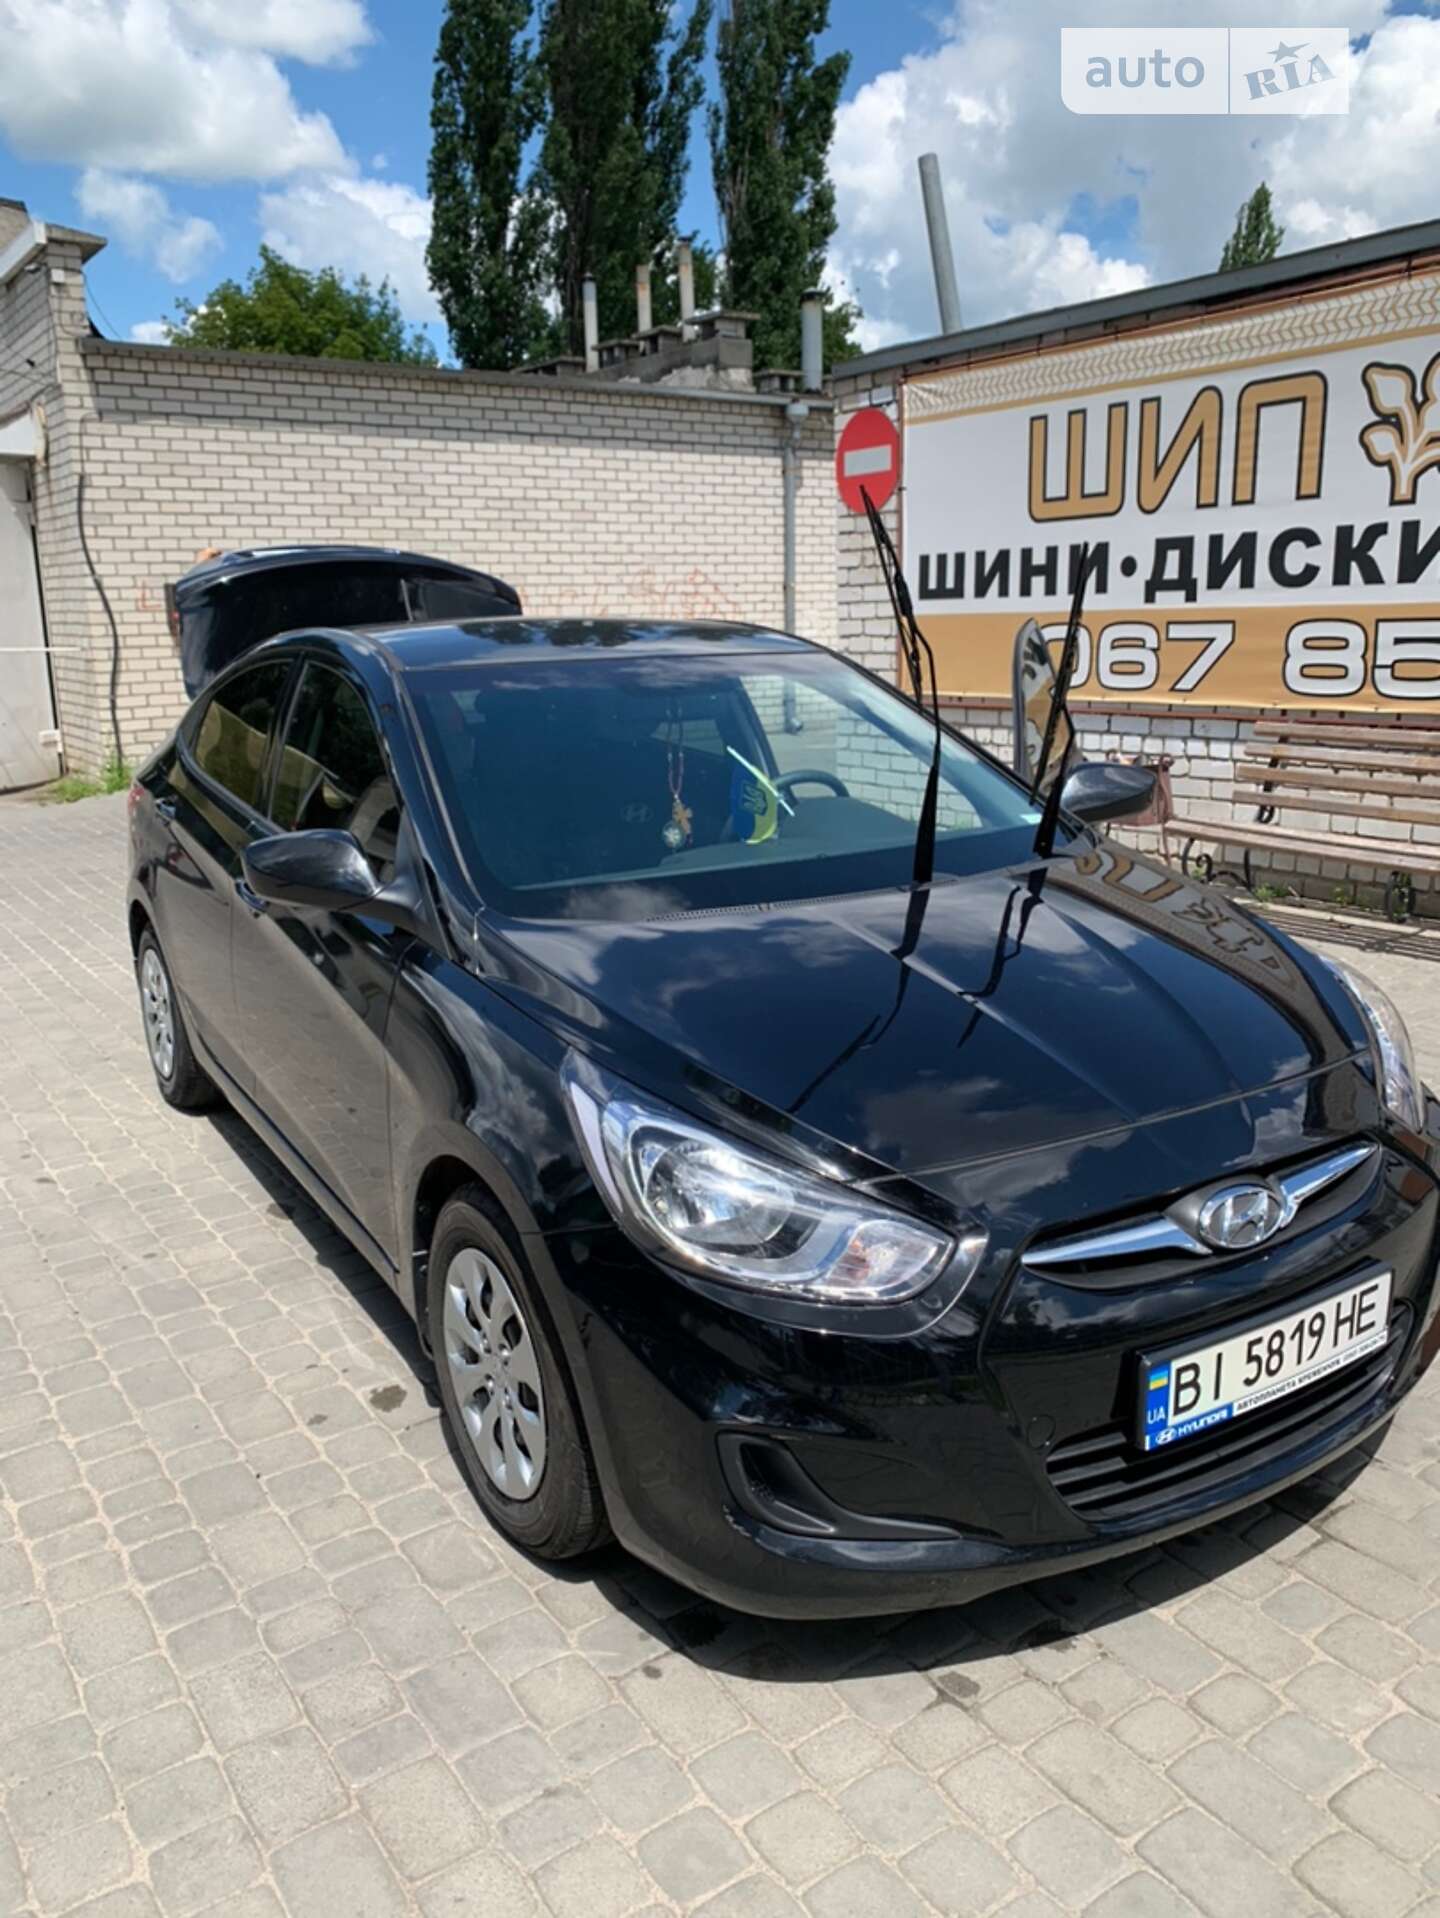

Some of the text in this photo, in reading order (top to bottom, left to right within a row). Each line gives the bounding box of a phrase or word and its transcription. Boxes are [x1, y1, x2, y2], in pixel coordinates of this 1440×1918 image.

[1028, 370, 1328, 523] ШИП
[1173, 1352, 1223, 1416] BI
[1243, 1311, 1326, 1386] 5819
[1332, 1283, 1379, 1348] HE
[1147, 1405, 1166, 1425] UA
[1177, 1408, 1229, 1438] HYUNDAI
